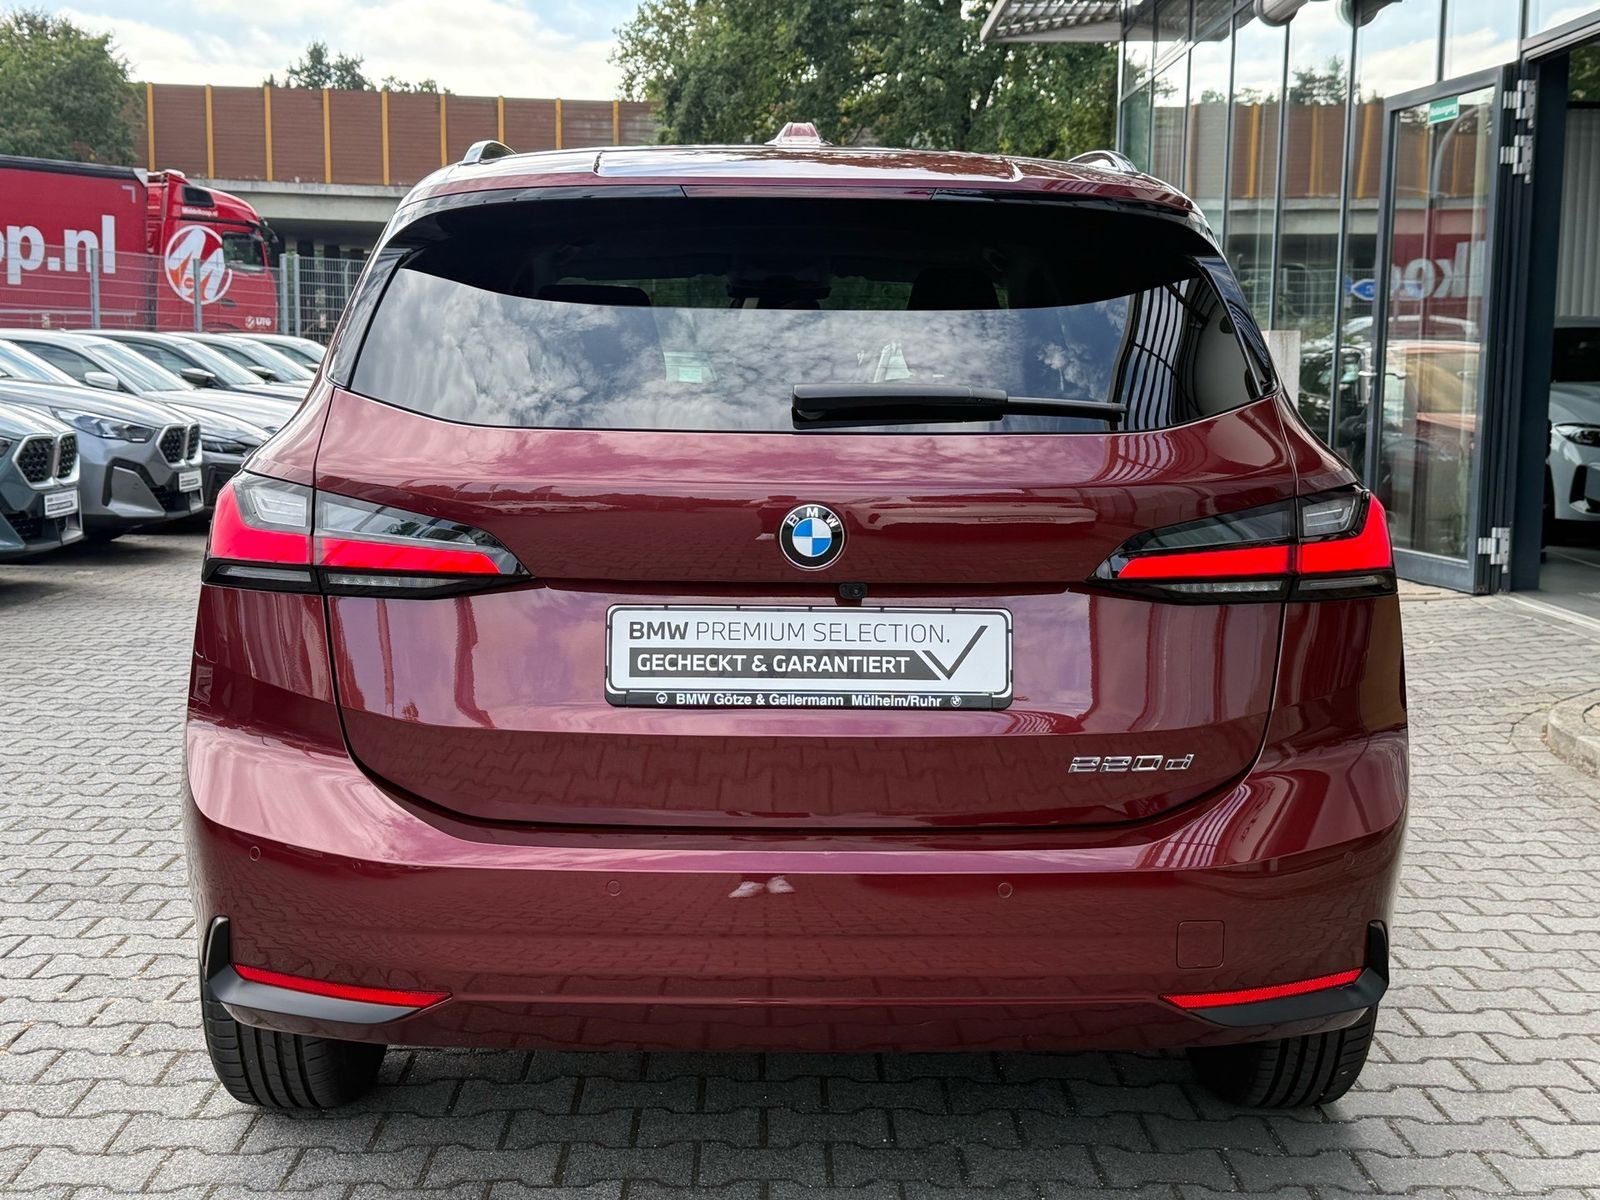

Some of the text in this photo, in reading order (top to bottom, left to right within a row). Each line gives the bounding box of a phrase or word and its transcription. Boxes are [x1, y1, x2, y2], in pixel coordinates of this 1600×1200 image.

[0, 214, 116, 285] p.nl
[786, 507, 839, 528] BMW
[629, 621, 950, 644] BMW PREMIUM SELECTION.
[637, 653, 911, 674] GECHECKT & GARANTIERT
[676, 692, 942, 708] BMW Götze & Gellermann Mülheim/Ruhr
[1068, 753, 1195, 774] 220d
